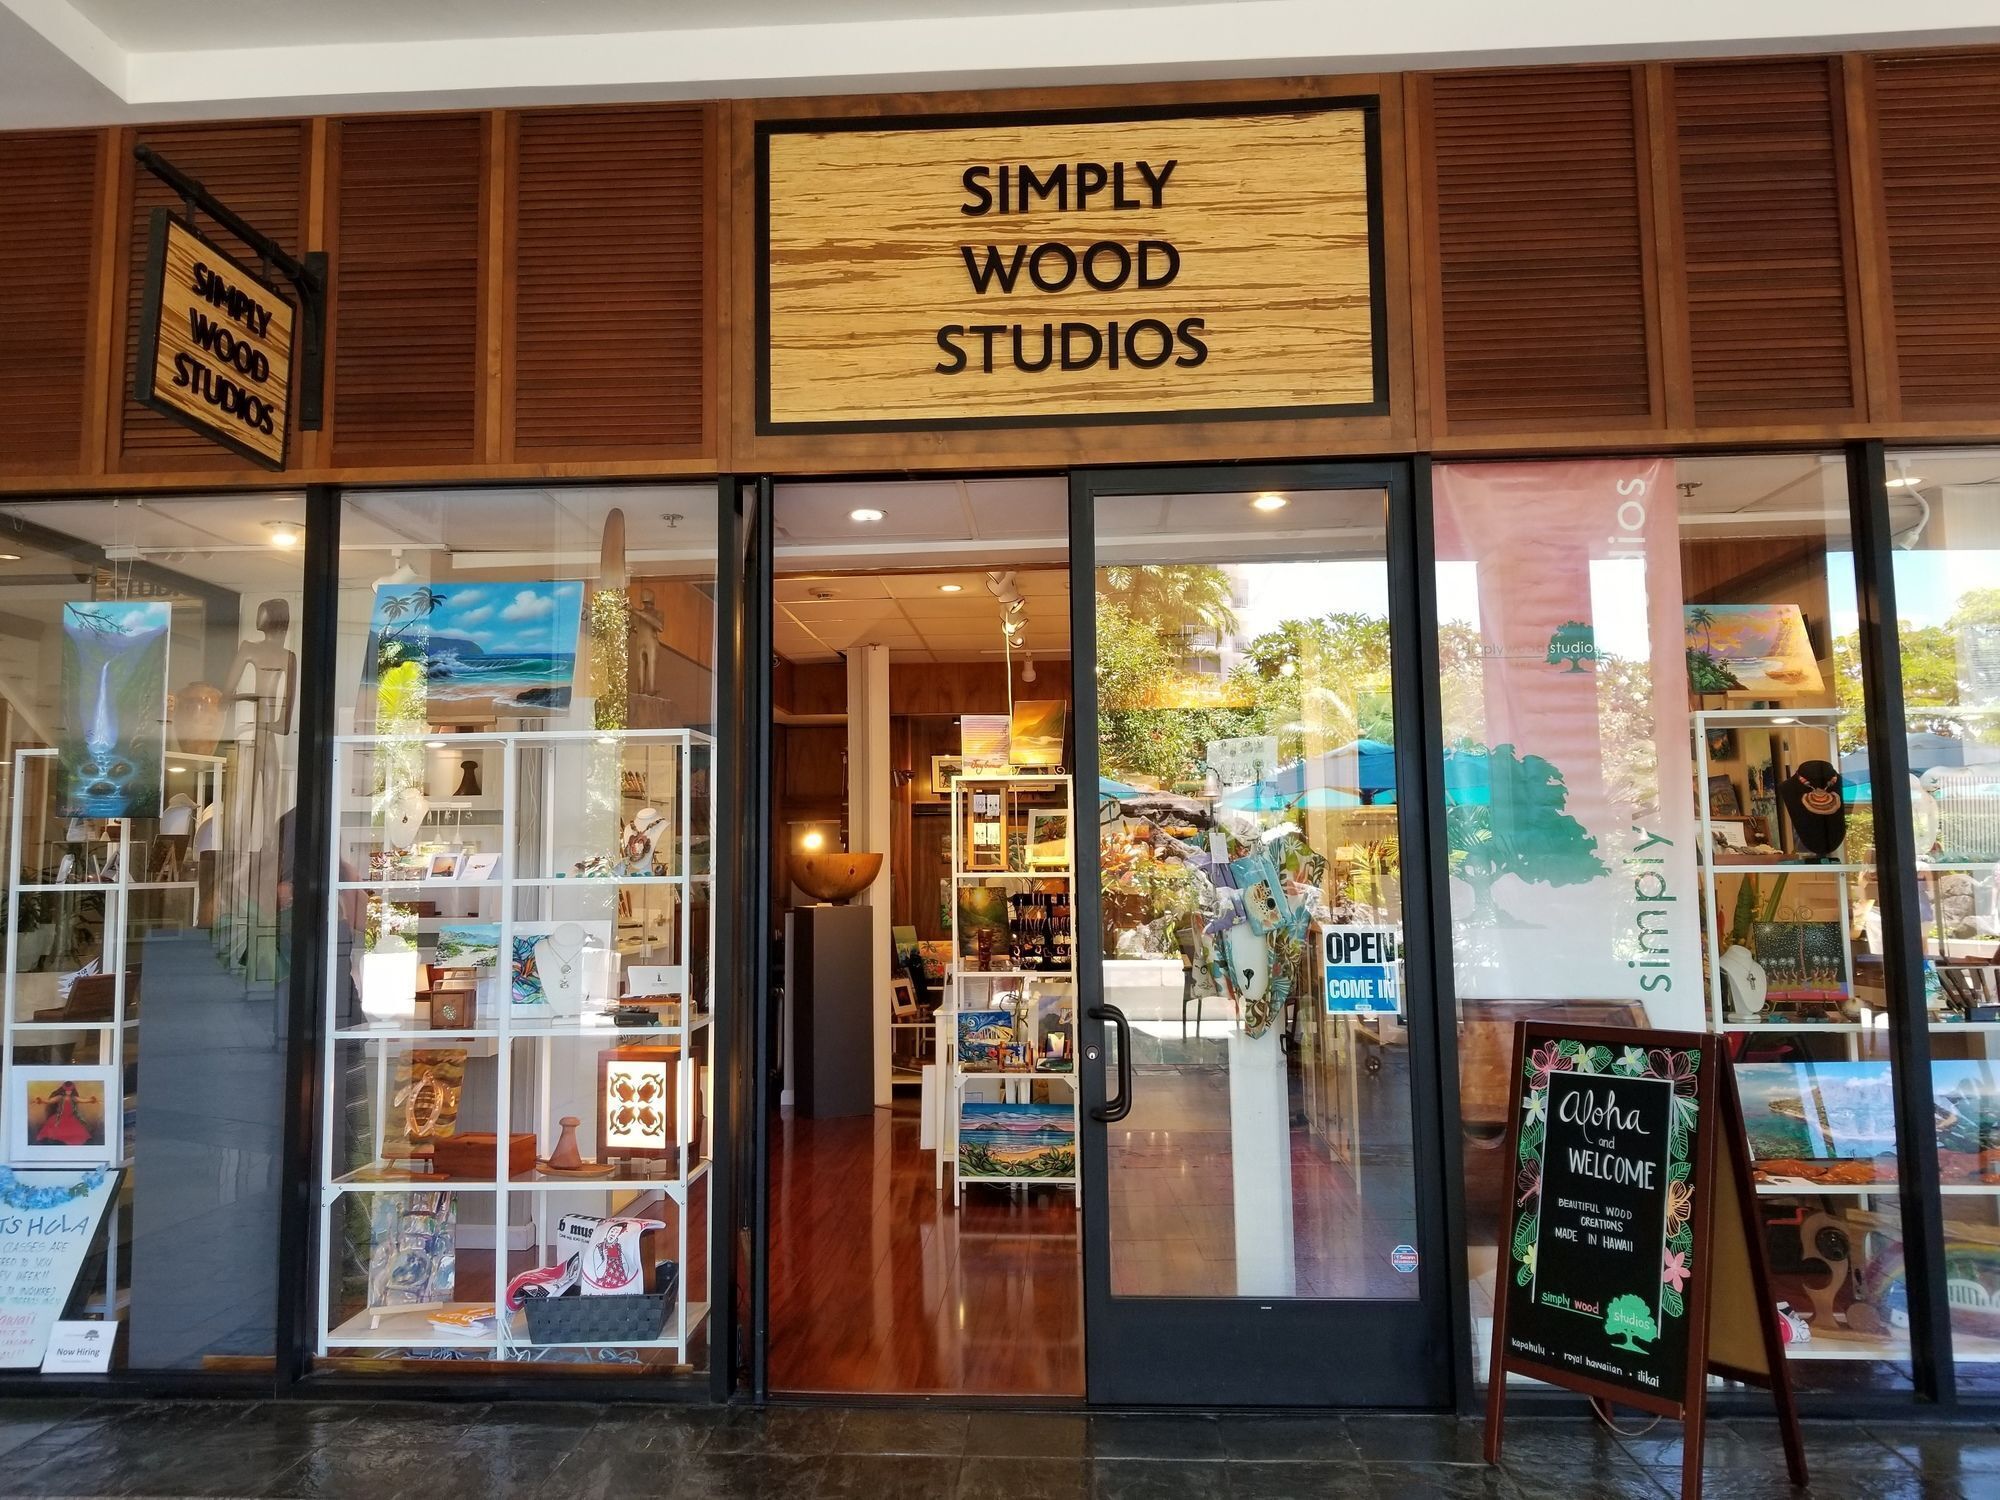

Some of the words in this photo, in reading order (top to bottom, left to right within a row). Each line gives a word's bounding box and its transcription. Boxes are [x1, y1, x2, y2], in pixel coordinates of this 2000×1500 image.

[961, 159, 1178, 216] SIMPLY
[960, 240, 1180, 294] WOOD
[191, 261, 273, 339] SIMPLY
[189, 306, 270, 384] WOOD
[935, 317, 1208, 375] STUDIOS
[173, 352, 274, 436] STUDIOS
[1623, 826, 1677, 993] simply
[1326, 931, 1395, 964] OPEN
[1329, 979, 1374, 999] COME
[1378, 979, 1395, 999] IN
[1559, 1089, 1650, 1144] Aloha
[1599, 1136, 1615, 1149] and
[1569, 1147, 1656, 1190] WELCOME
[27, 1214, 90, 1237] HULA
[1558, 1198, 1600, 1214] BEAUTIFUL
[1605, 1206, 1632, 1220] WOOD
[1580, 1216, 1624, 1232] CREATIONS
[1555, 1227, 1578, 1243] MADE
[1588, 1232, 1597, 1246] IN
[1603, 1237, 1633, 1252] HAWAII
[1541, 1291, 1571, 1309] simply
[1574, 1299, 1599, 1315] wood
[1614, 1308, 1650, 1330] studios
[57, 1348, 75, 1356] Now
[76, 1348, 100, 1358] Hiring
[1511, 1337, 1546, 1356] kapahulu
[1564, 1352, 1583, 1365] royal
[1585, 1356, 1623, 1376] hawaiian
[1637, 1370, 1660, 1388] ilikai
